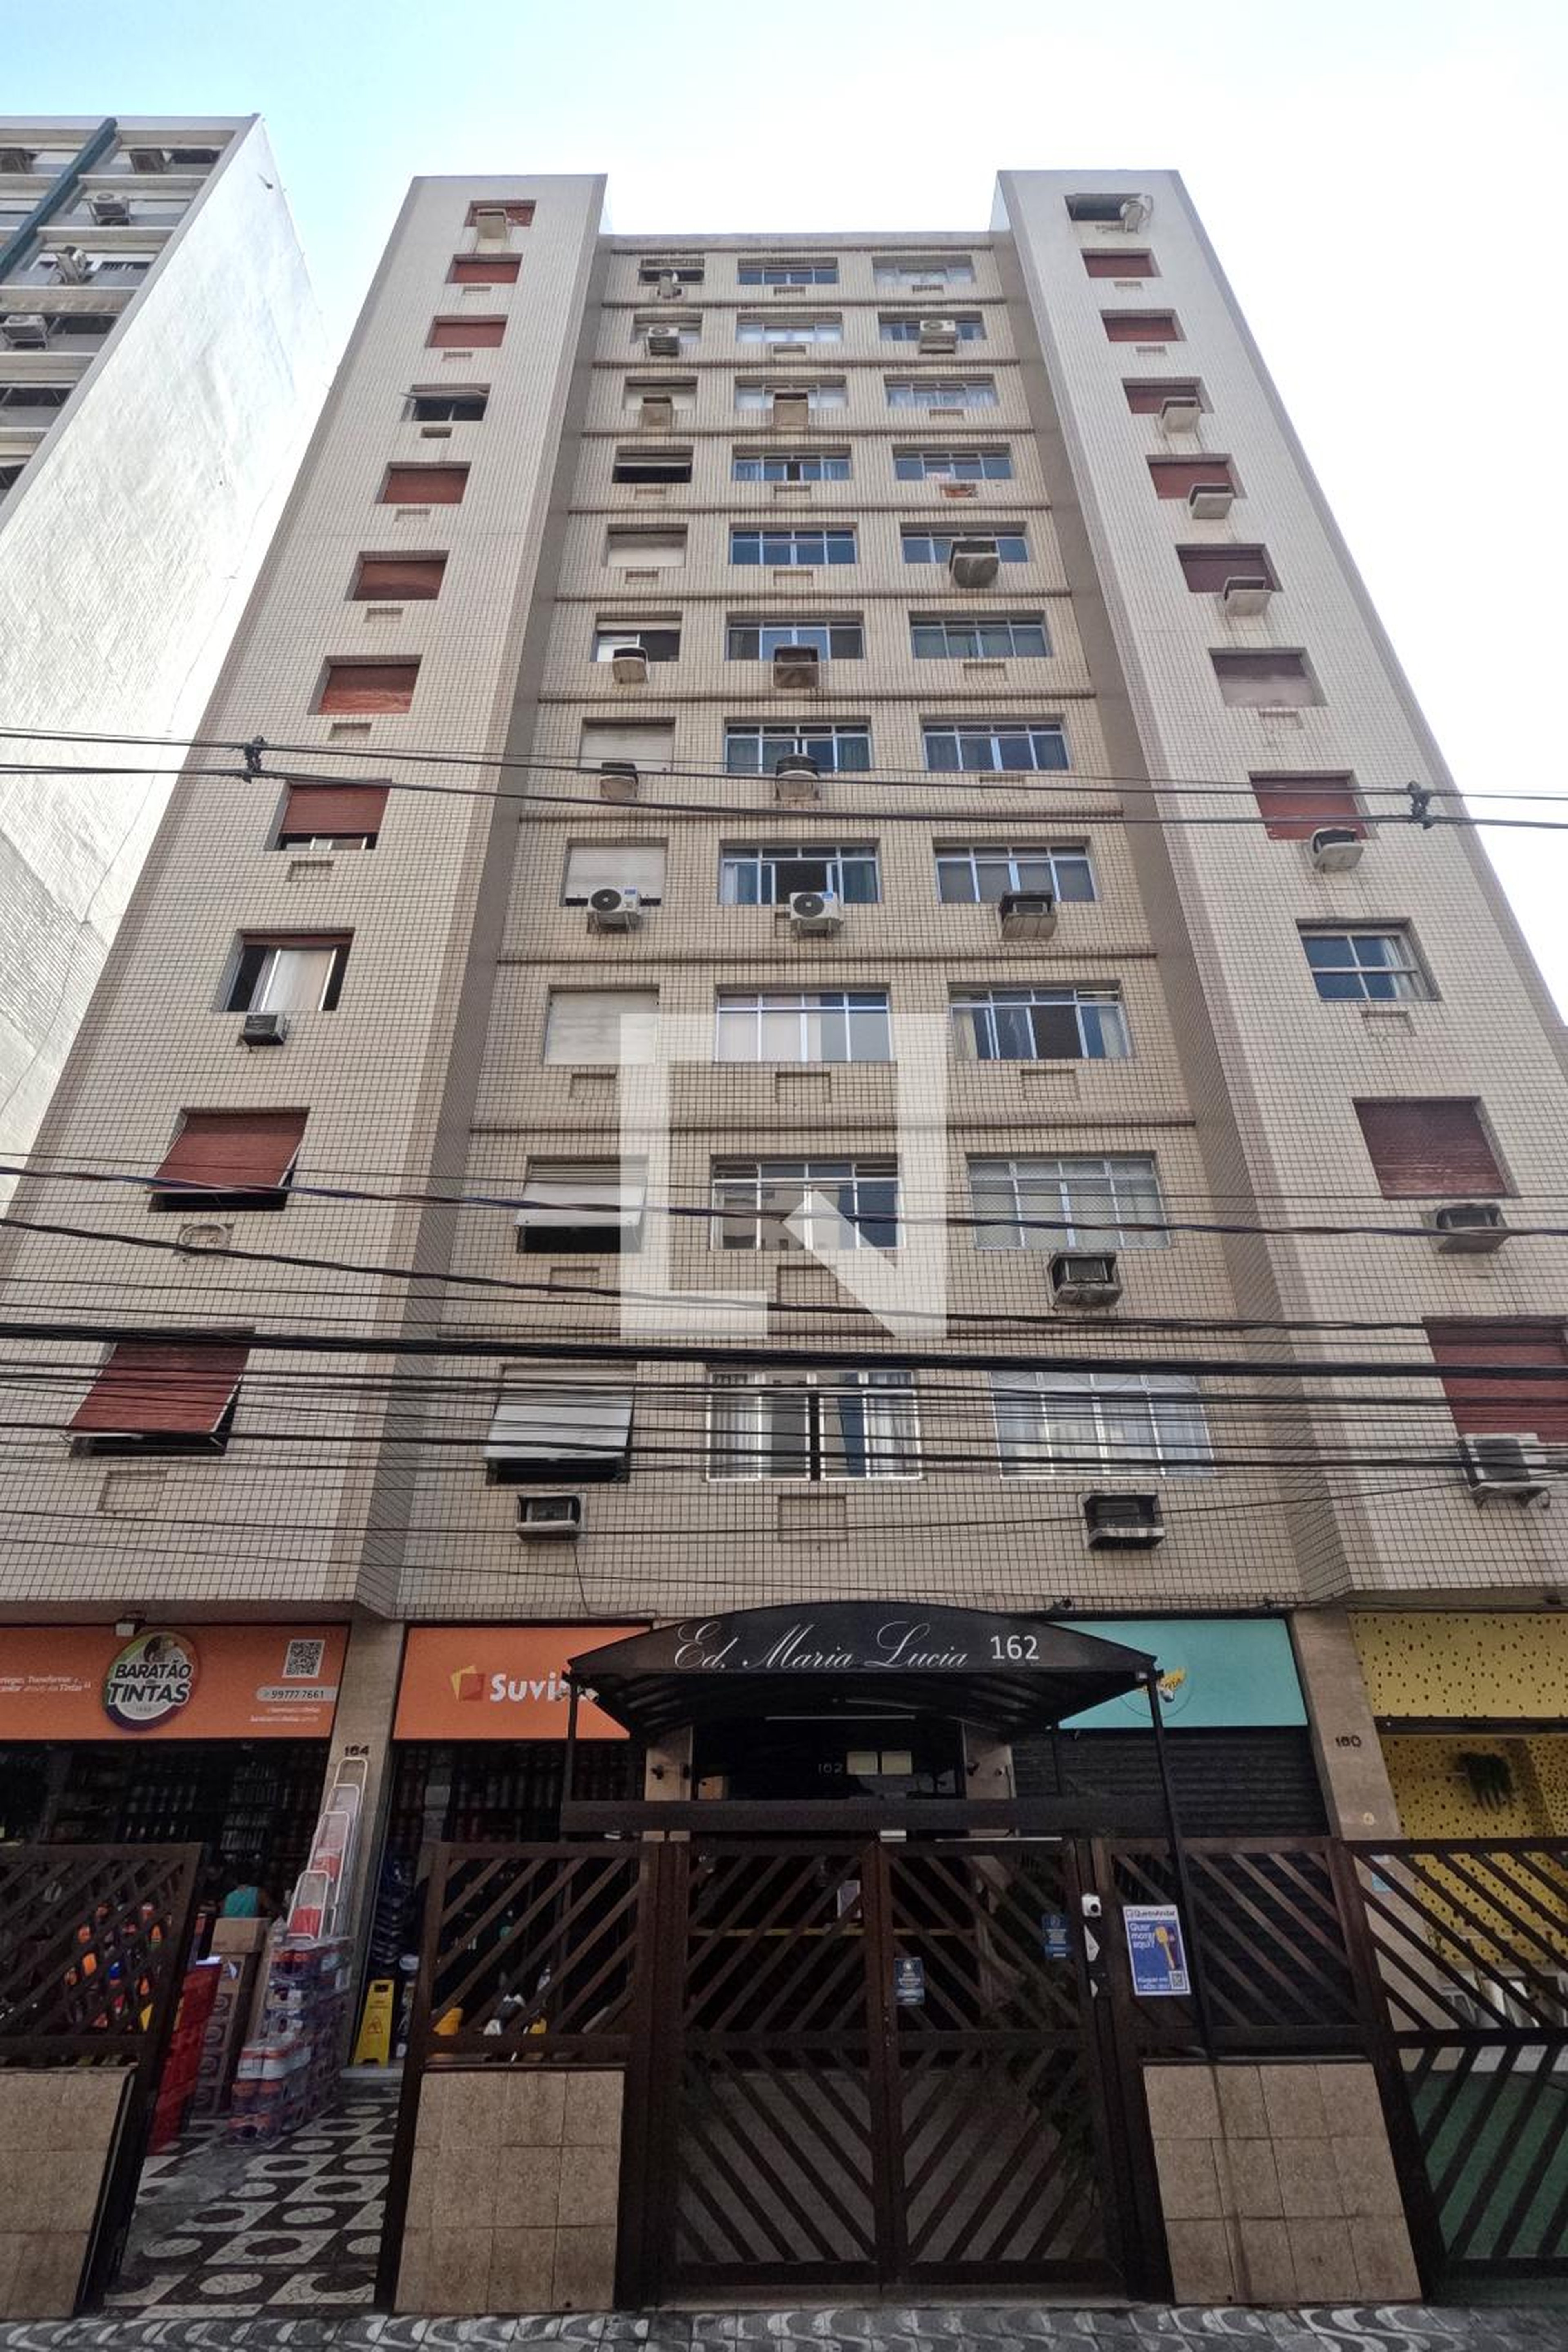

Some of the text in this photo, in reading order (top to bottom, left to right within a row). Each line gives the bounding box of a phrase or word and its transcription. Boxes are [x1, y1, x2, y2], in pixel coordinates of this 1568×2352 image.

[675, 1621, 1040, 1669] Ed. Maria Lucia 162
[114, 1659, 192, 1679] BARATÃO
[109, 1682, 189, 1703] TINTAS
[490, 1671, 571, 1702] Suvi
